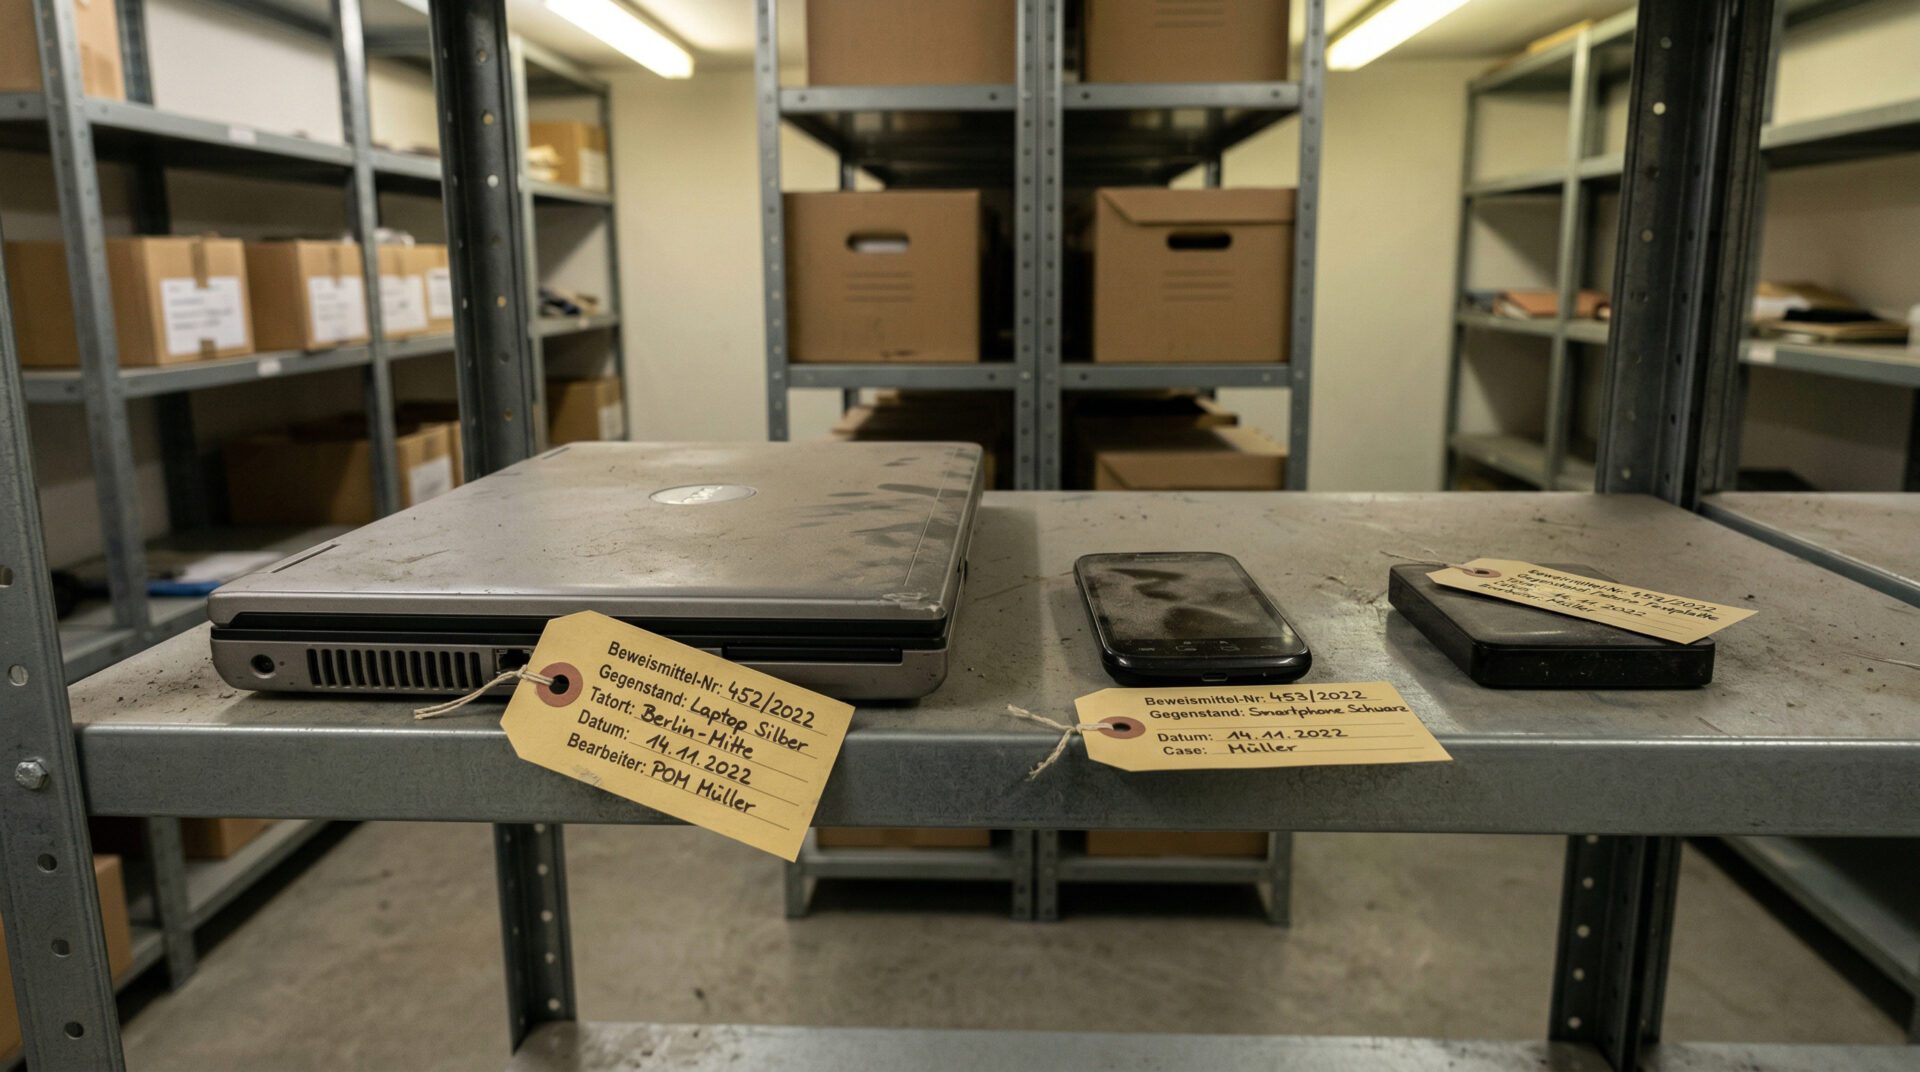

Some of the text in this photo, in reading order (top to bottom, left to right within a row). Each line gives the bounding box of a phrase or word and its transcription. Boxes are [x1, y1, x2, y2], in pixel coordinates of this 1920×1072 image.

[607, 640, 815, 729] Beweismittel-Nr: 452/2022
[1269, 689, 1368, 703] 453/2022
[590, 686, 636, 716] Tatort:
[599, 664, 809, 752] Gegenstand: Laptop Silber
[1149, 708, 1245, 720] Gegenstand:
[577, 708, 630, 741] Datum:
[1157, 733, 1213, 742] Datum:
[1162, 743, 1299, 756] Case: Müller
[566, 732, 757, 813] Bearbeiter: POM Müller
